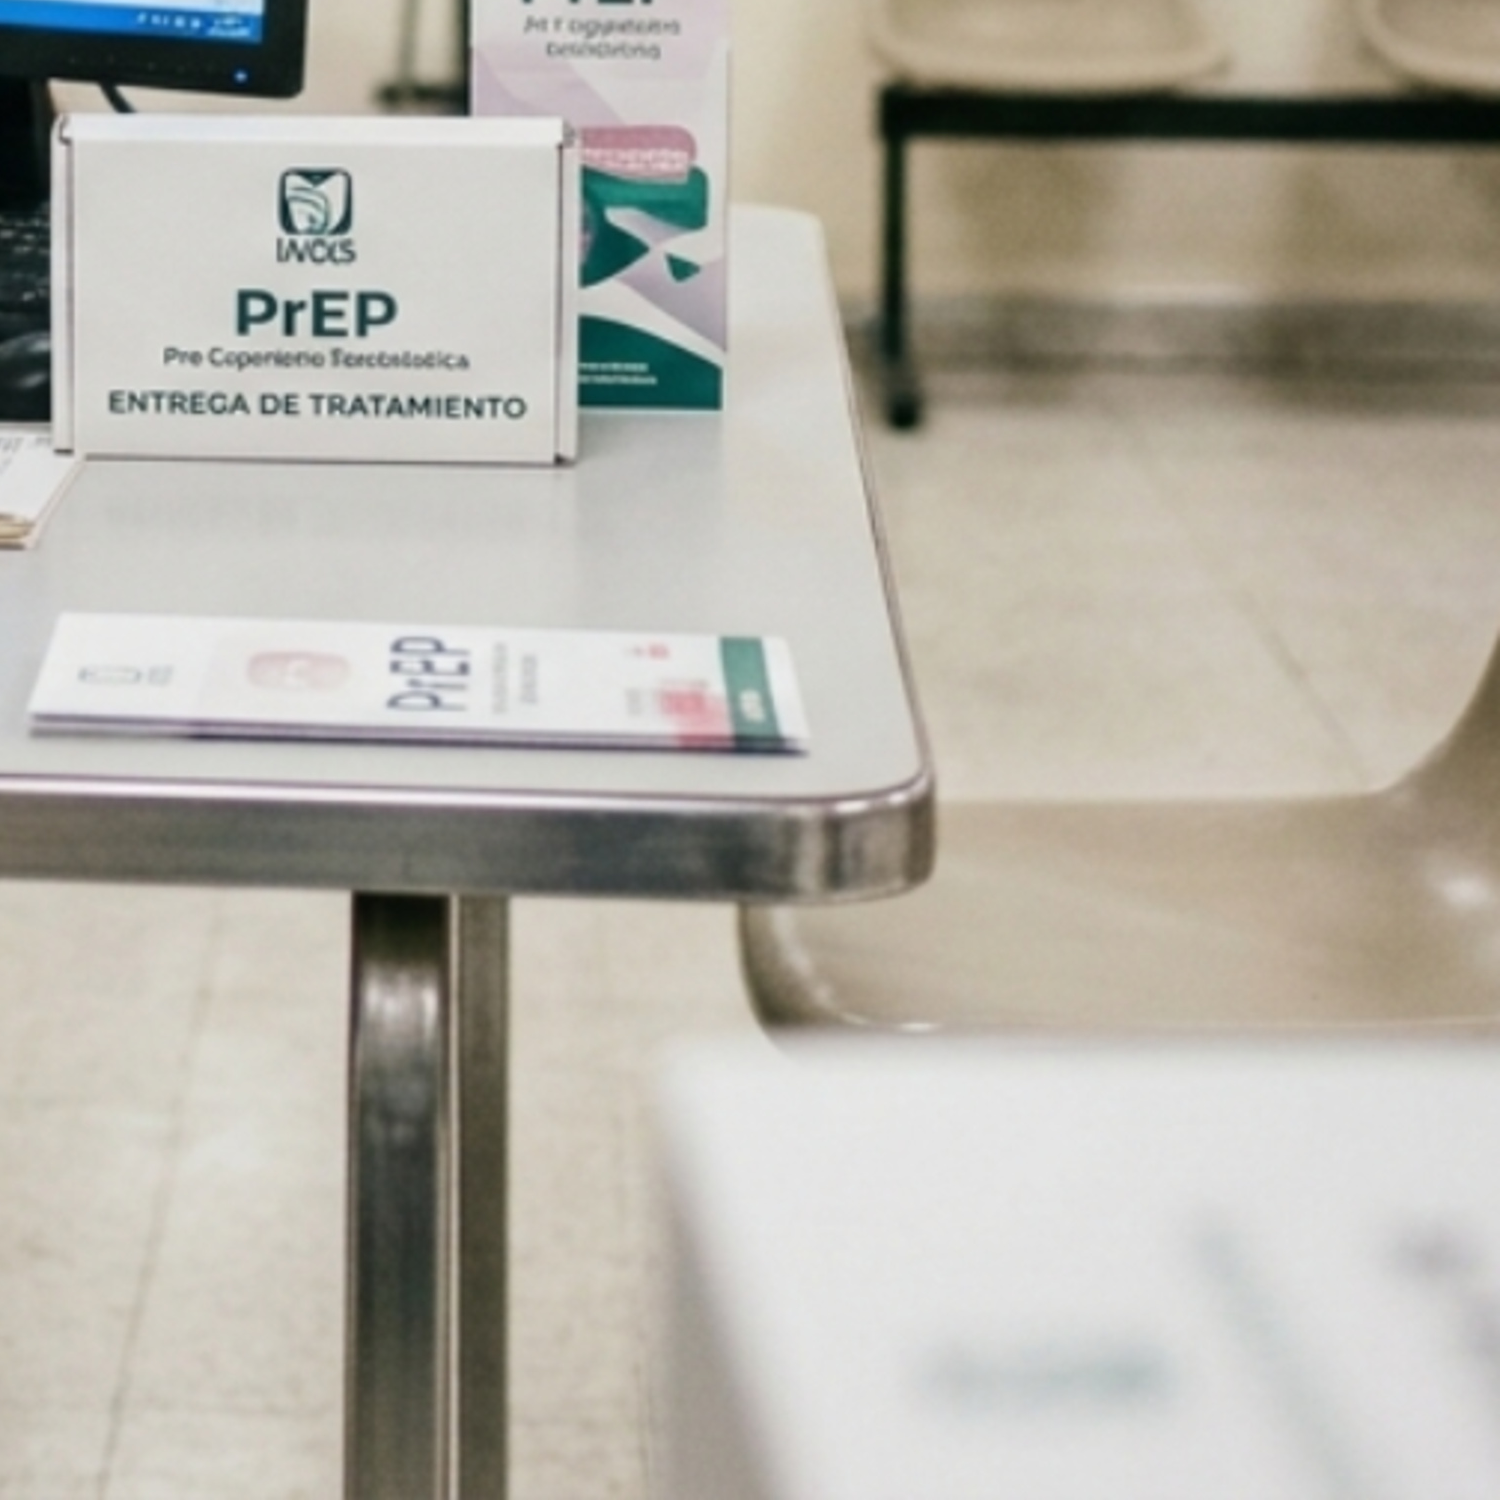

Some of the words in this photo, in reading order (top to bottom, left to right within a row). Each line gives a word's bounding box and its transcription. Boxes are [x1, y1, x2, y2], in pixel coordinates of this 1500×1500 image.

[236, 289, 398, 338] PrEP
[109, 390, 251, 416] ENTREGA
[260, 393, 300, 416] DE
[309, 393, 528, 420] TRATAMIENTO
